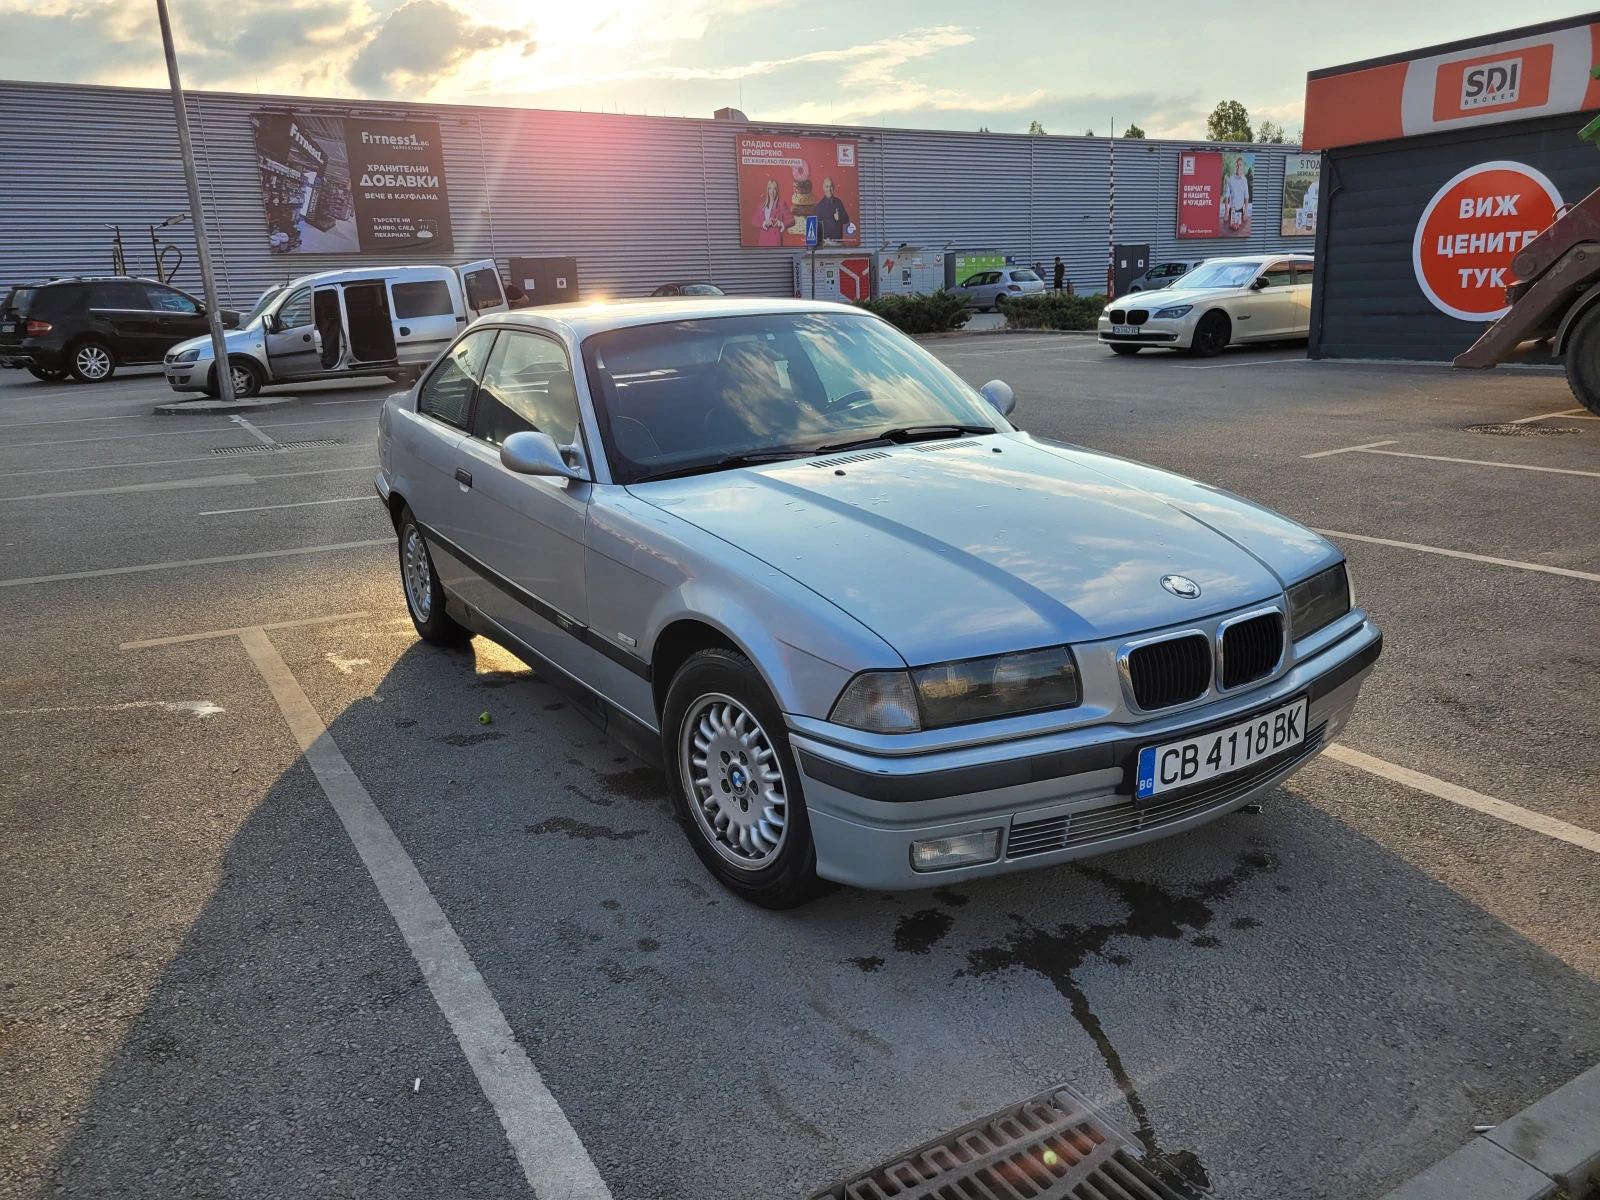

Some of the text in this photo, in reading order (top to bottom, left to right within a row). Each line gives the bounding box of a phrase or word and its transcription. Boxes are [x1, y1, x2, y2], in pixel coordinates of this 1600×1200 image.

[1465, 64, 1518, 97] SDI
[1464, 92, 1515, 106] BROKER
[741, 140, 802, 150] СЛАДКО. СОЛЕНО.
[741, 149, 784, 157] ПРОВЕРЕНО.
[367, 164, 429, 174] ХРАНИТЕЛНИ
[1300, 159, 1305, 170] 5
[360, 174, 439, 188] ДОБАВКИ
[364, 192, 384, 200] ВЕЧЕ
[395, 193, 438, 201] КАУФЛАНД
[1459, 194, 1521, 219] ВИЖ
[1458, 267, 1507, 289] ТУК
[1139, 779, 1153, 791] BG
